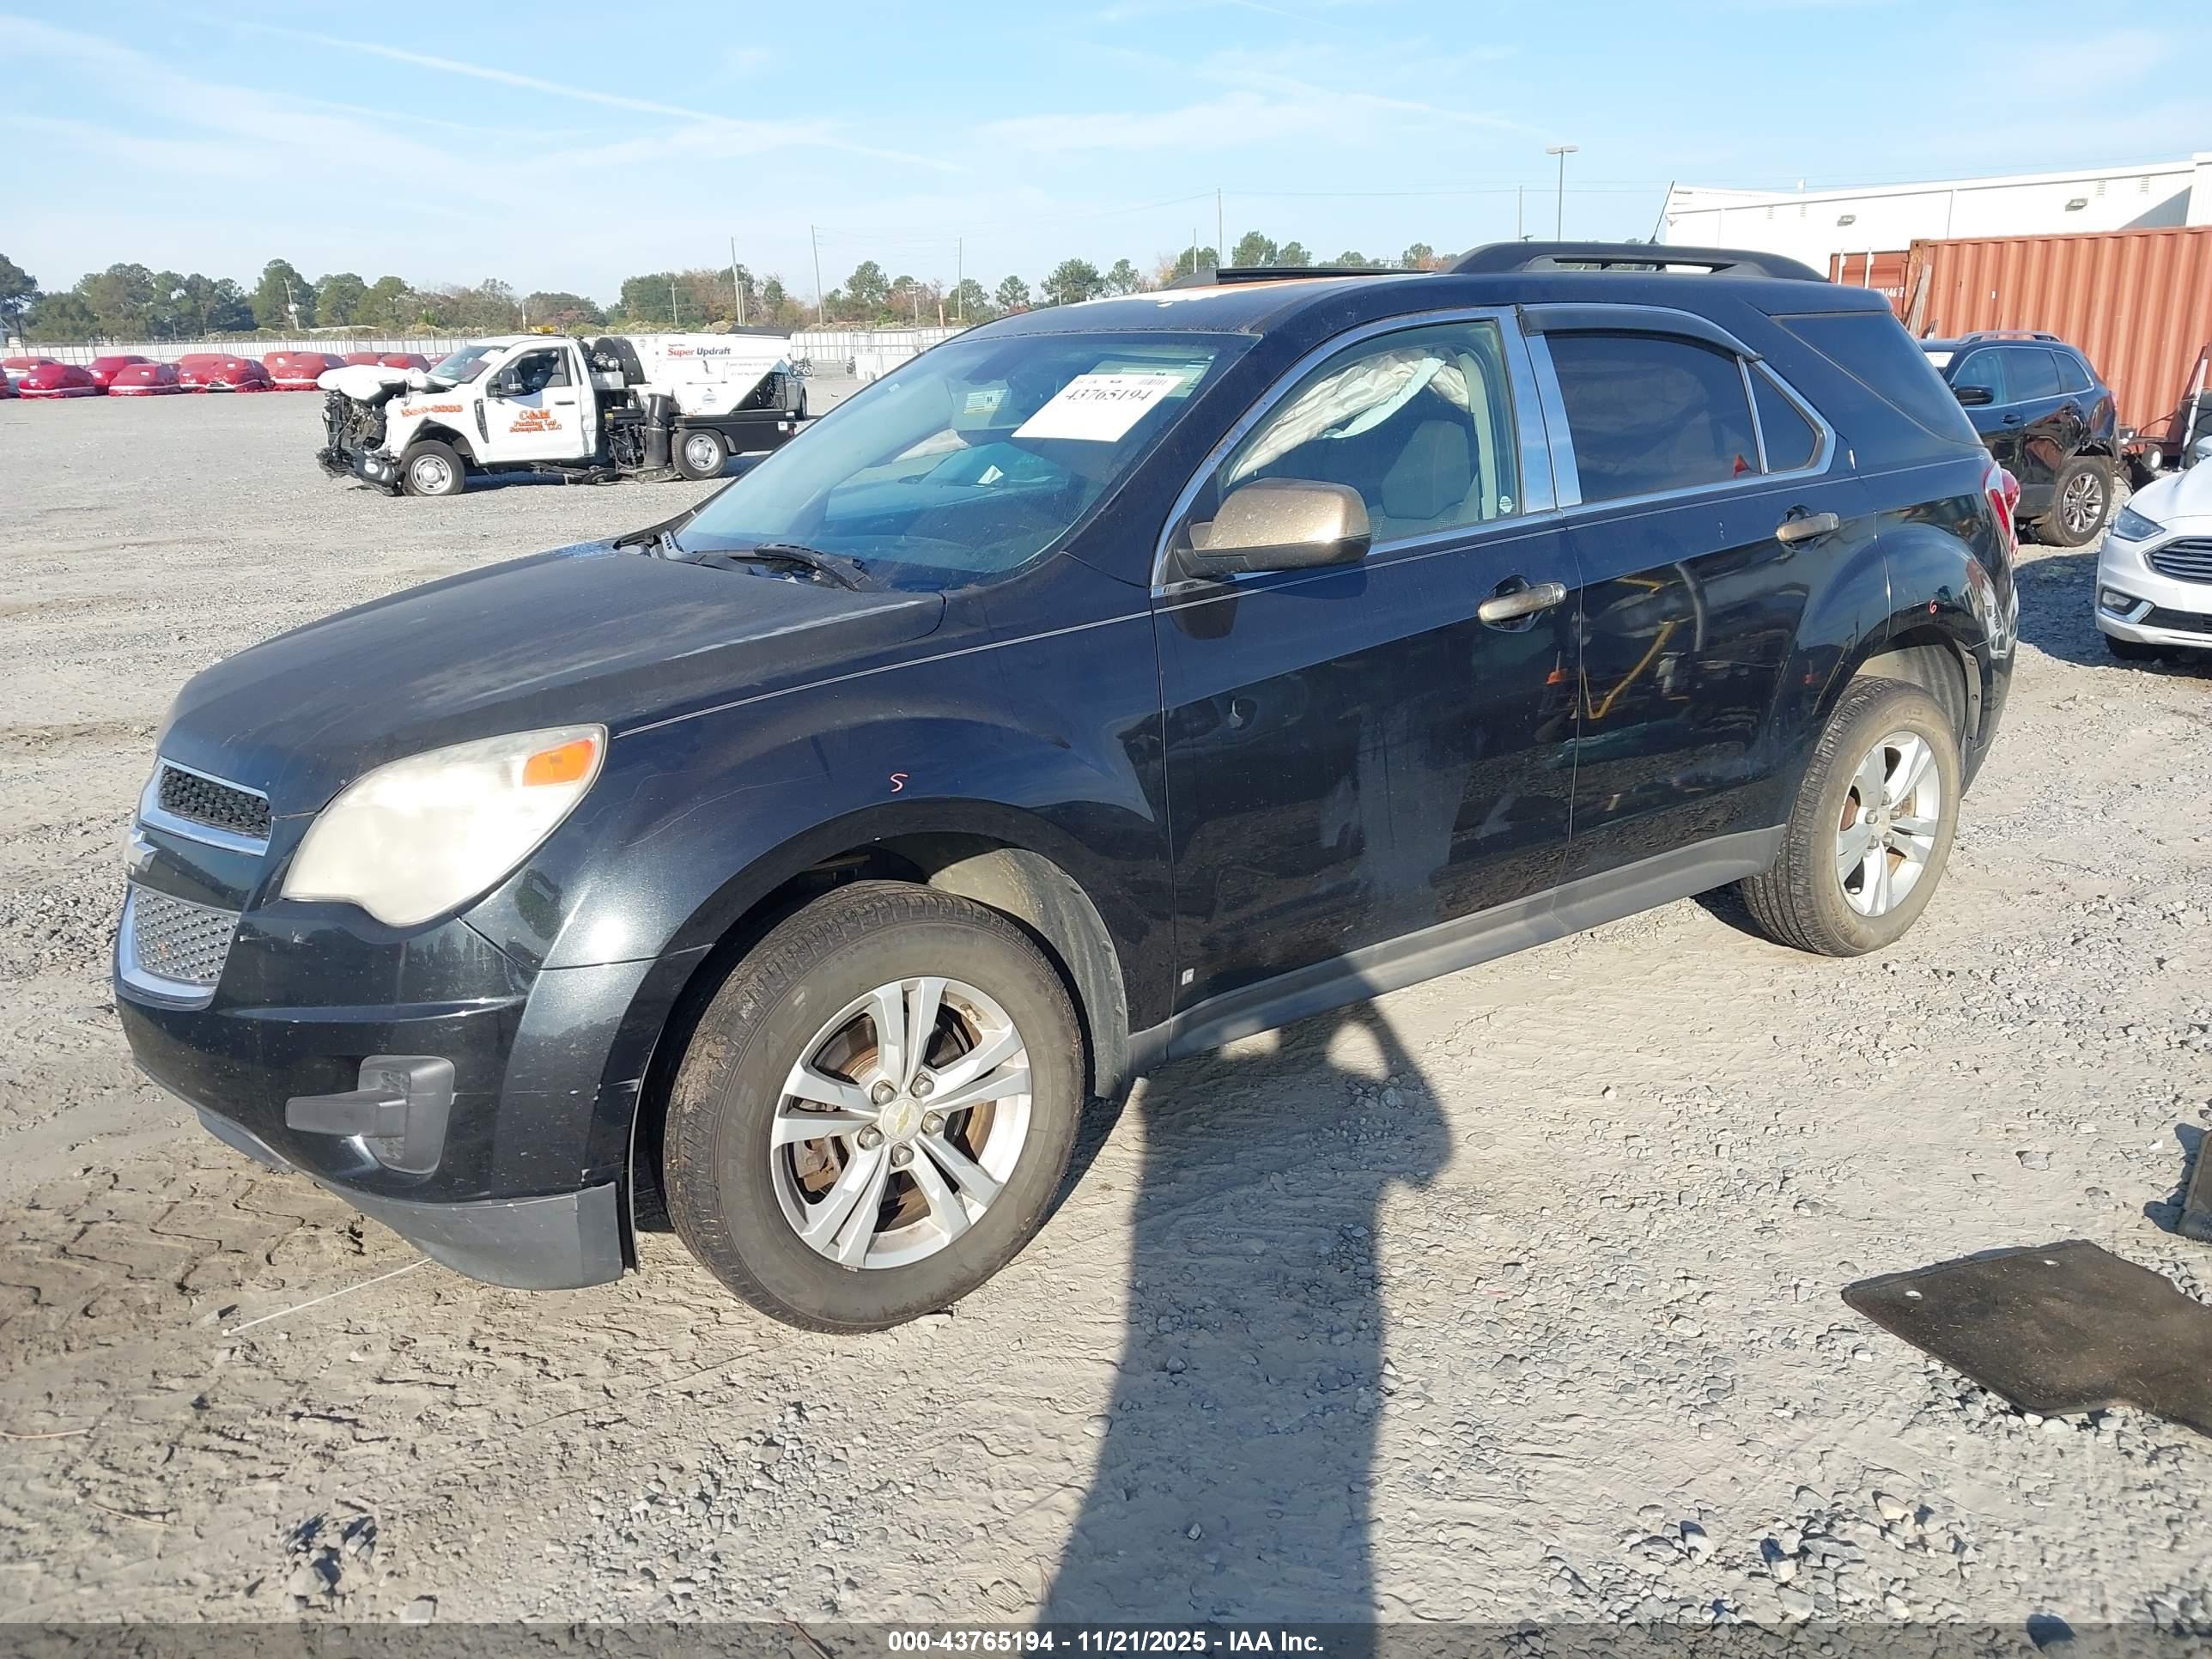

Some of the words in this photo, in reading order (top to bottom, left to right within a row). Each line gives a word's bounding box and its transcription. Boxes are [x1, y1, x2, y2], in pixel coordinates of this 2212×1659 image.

[667, 347, 695, 358] Super
[696, 346, 731, 357] Updraft
[1065, 389, 1154, 402] 43765194
